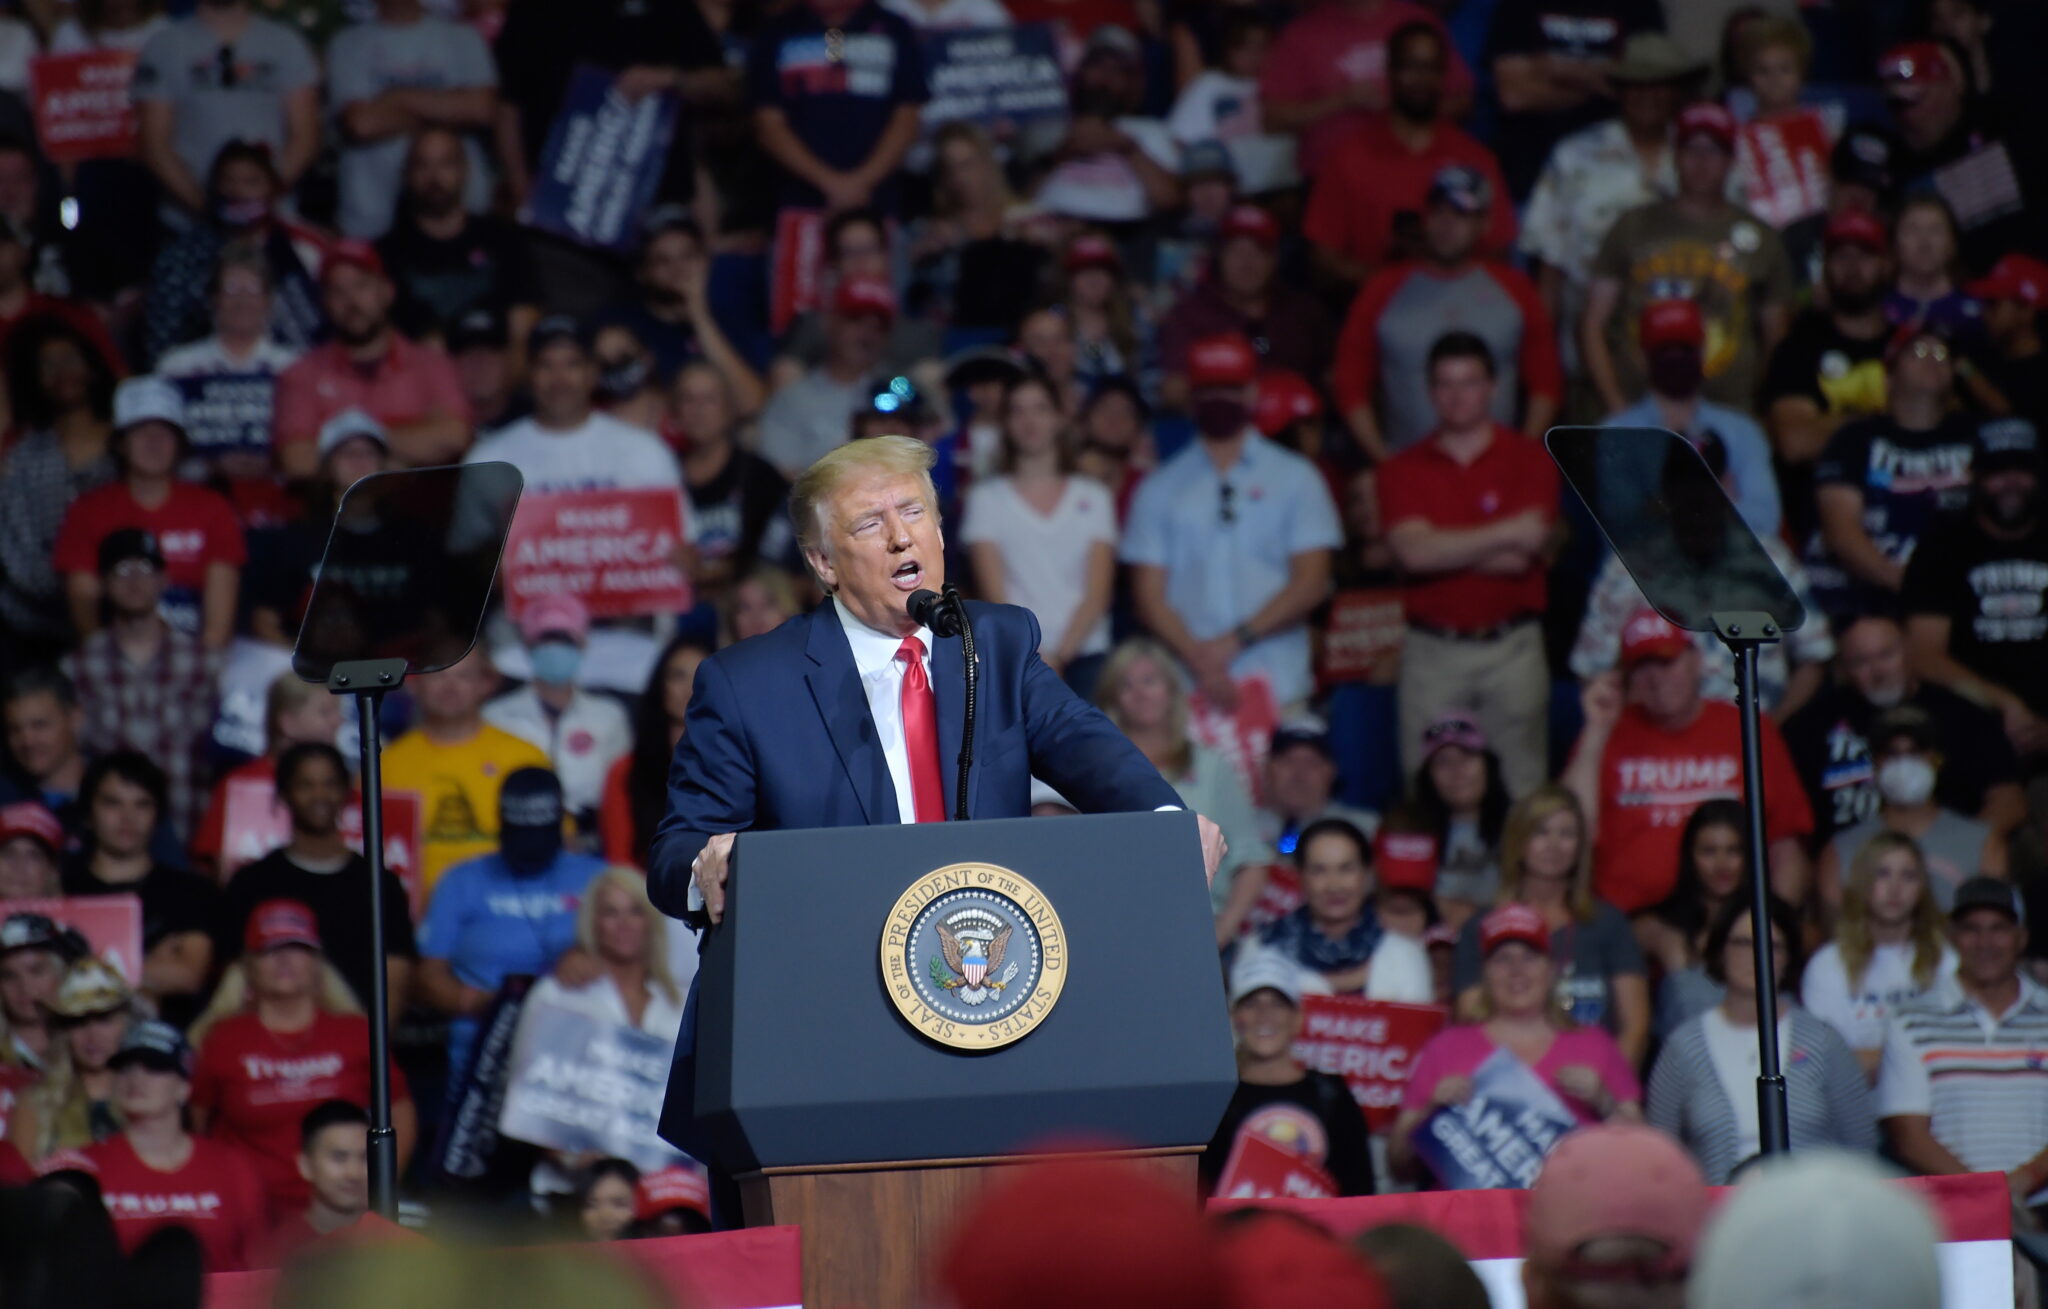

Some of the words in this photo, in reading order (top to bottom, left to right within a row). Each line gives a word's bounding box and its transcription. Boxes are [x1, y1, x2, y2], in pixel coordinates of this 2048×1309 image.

[1617, 754, 1738, 791] TRUMP
[977, 872, 996, 885] OF
[997, 876, 1021, 896] THE
[888, 870, 972, 948] PRESIDENT
[1024, 893, 1061, 971] UNITED
[890, 954, 902, 981] THE
[896, 983, 911, 1000] OF
[908, 998, 956, 1039] SEAL
[988, 987, 1052, 1041] STATES
[1308, 1013, 1390, 1044] MAKE
[1463, 1096, 1544, 1190] AMER
[1516, 1109, 1557, 1154] MA
